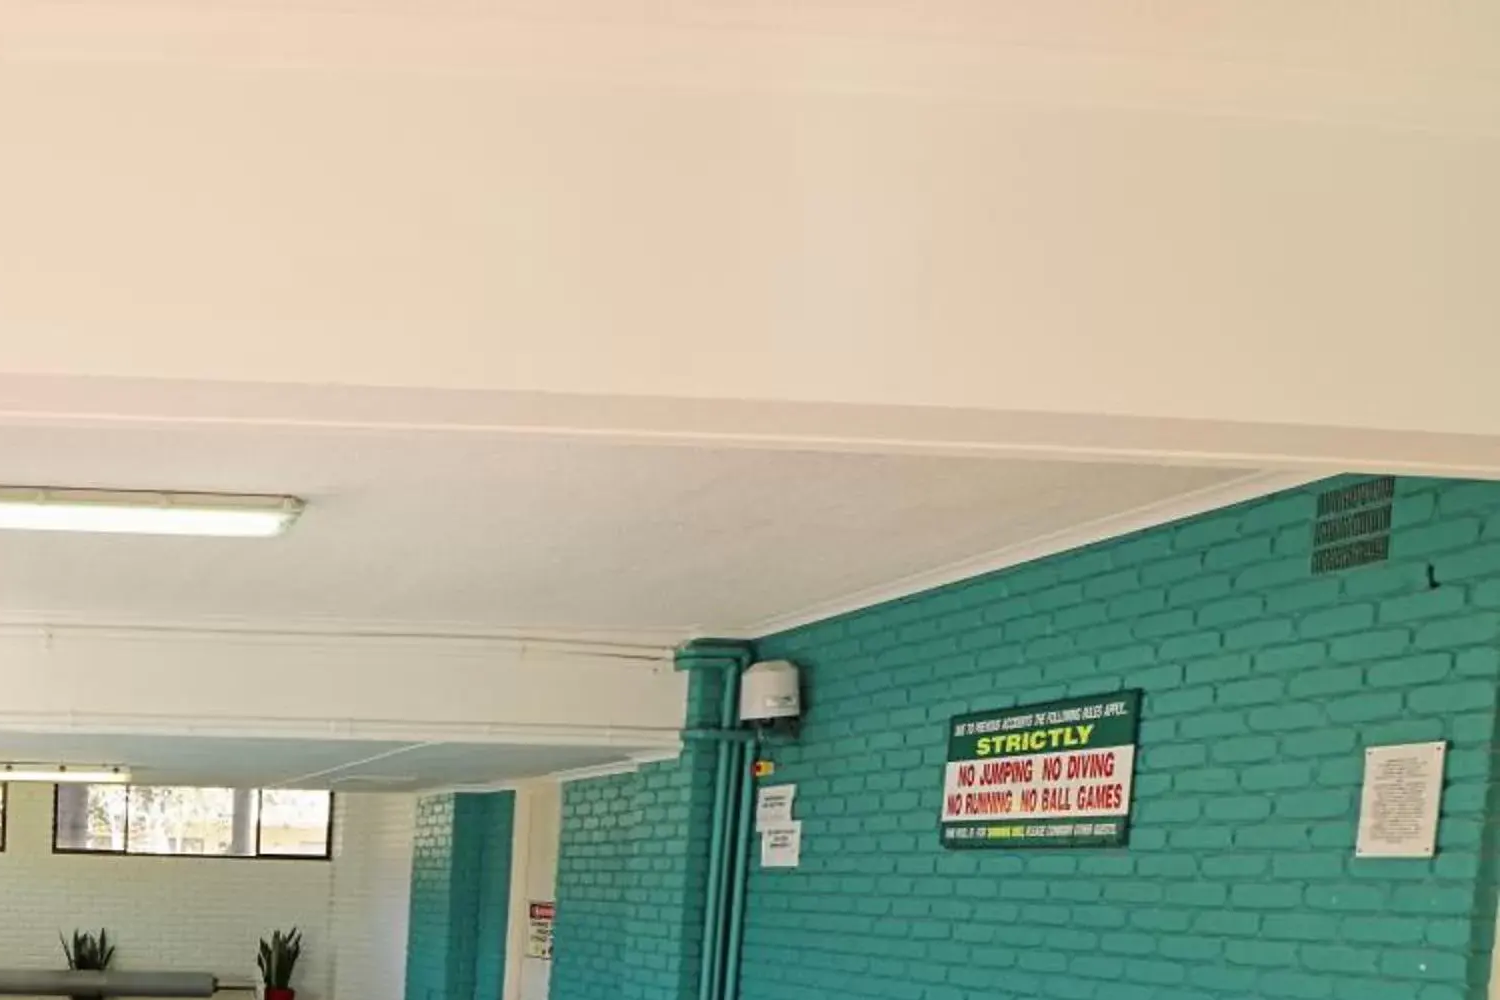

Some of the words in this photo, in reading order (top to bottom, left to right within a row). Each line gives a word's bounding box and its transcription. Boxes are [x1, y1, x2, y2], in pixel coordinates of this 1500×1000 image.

[976, 724, 1095, 756] STRICTLY
[958, 764, 975, 787] NO
[980, 759, 1033, 786] JUMPING
[1042, 756, 1061, 780] NO
[1068, 752, 1114, 778] DIVING
[947, 793, 962, 816] NO
[965, 790, 1013, 815] RUNNING
[1021, 789, 1037, 812] NO
[1041, 787, 1071, 811] BALL
[1077, 784, 1123, 810] GAMES
